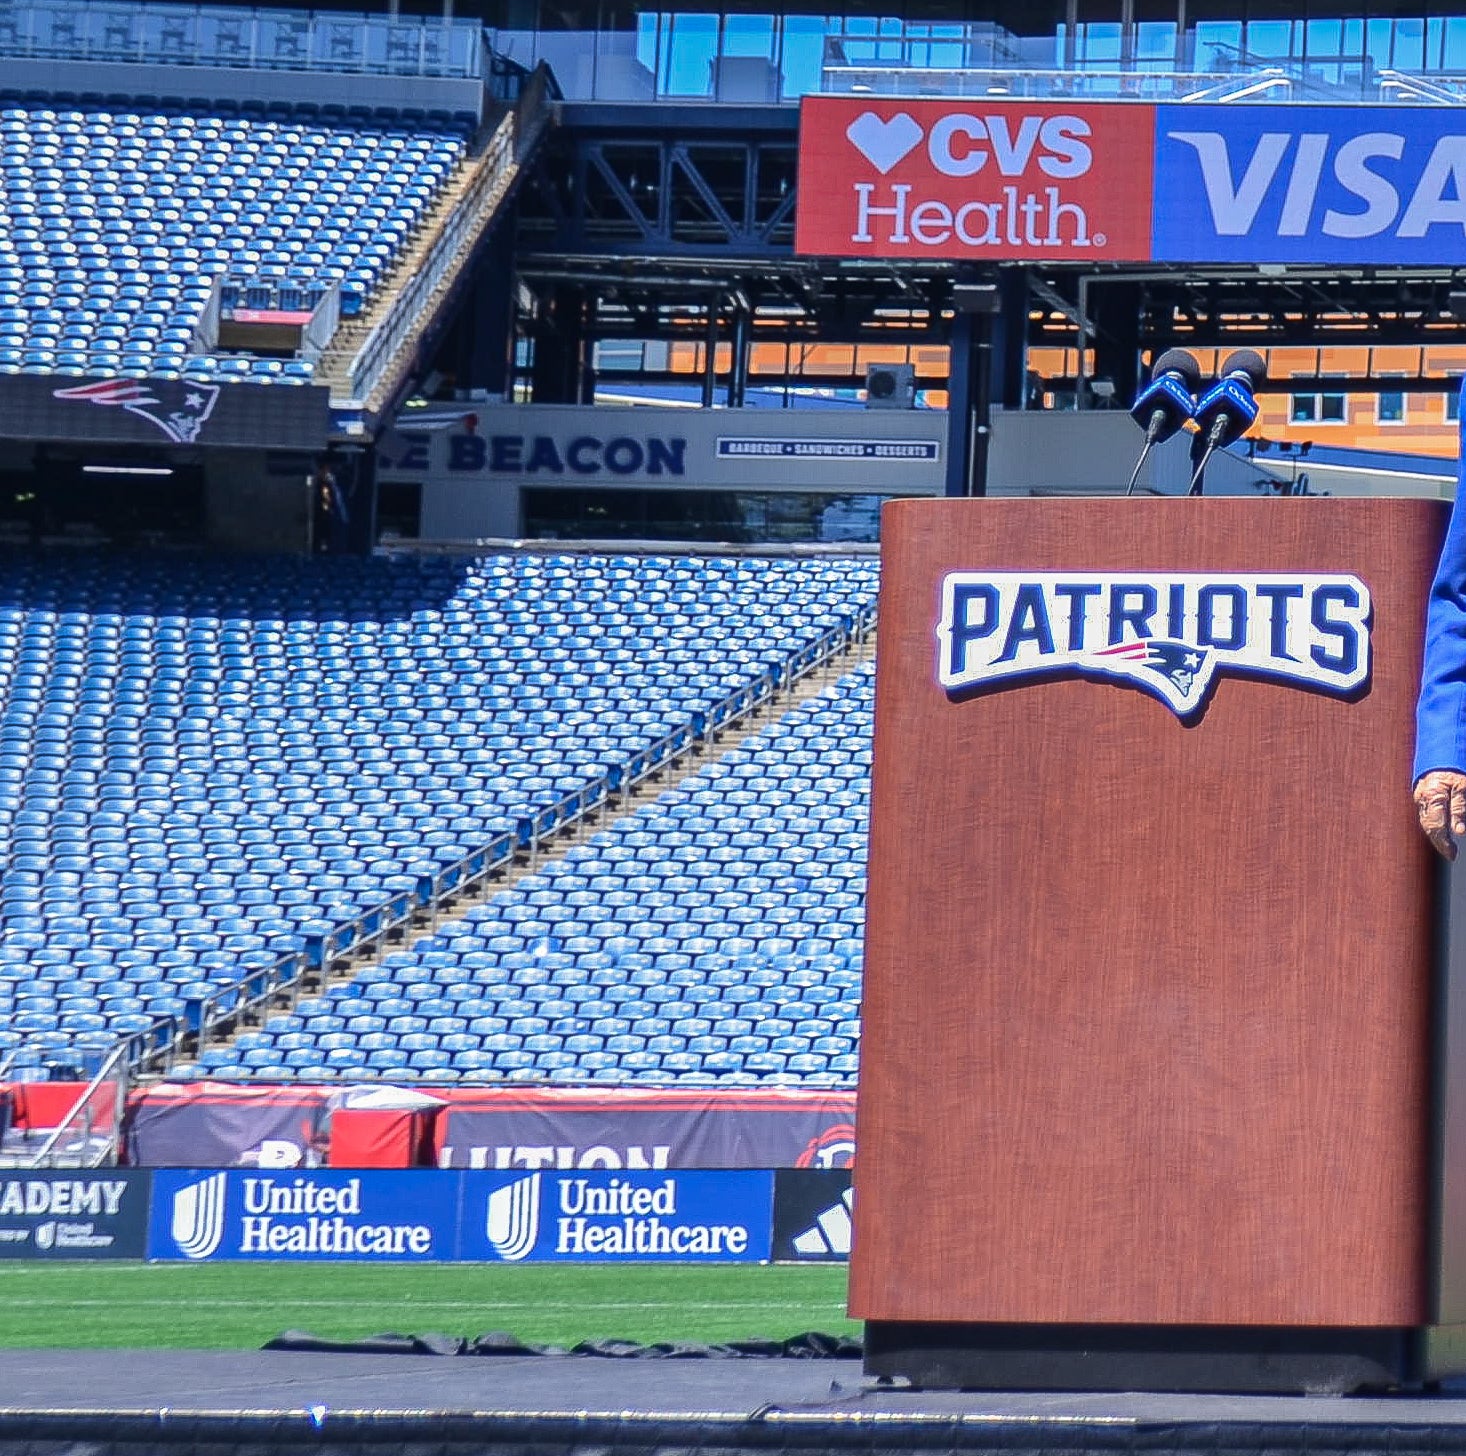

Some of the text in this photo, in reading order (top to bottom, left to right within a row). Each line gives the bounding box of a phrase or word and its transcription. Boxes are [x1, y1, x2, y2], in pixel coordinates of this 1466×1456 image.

[928, 112, 1094, 179] CVS
[447, 434, 688, 476] BEACON
[794, 443, 864, 456] SANDWICHES
[874, 445, 928, 457] DESSERTS
[948, 582, 1362, 676] PATRIOTS
[0, 1180, 129, 1216] ADEMY
[243, 1178, 361, 1215] United
[557, 1178, 676, 1216] United
[241, 1215, 431, 1255] Healthcare
[555, 1217, 748, 1255] Healthcare
